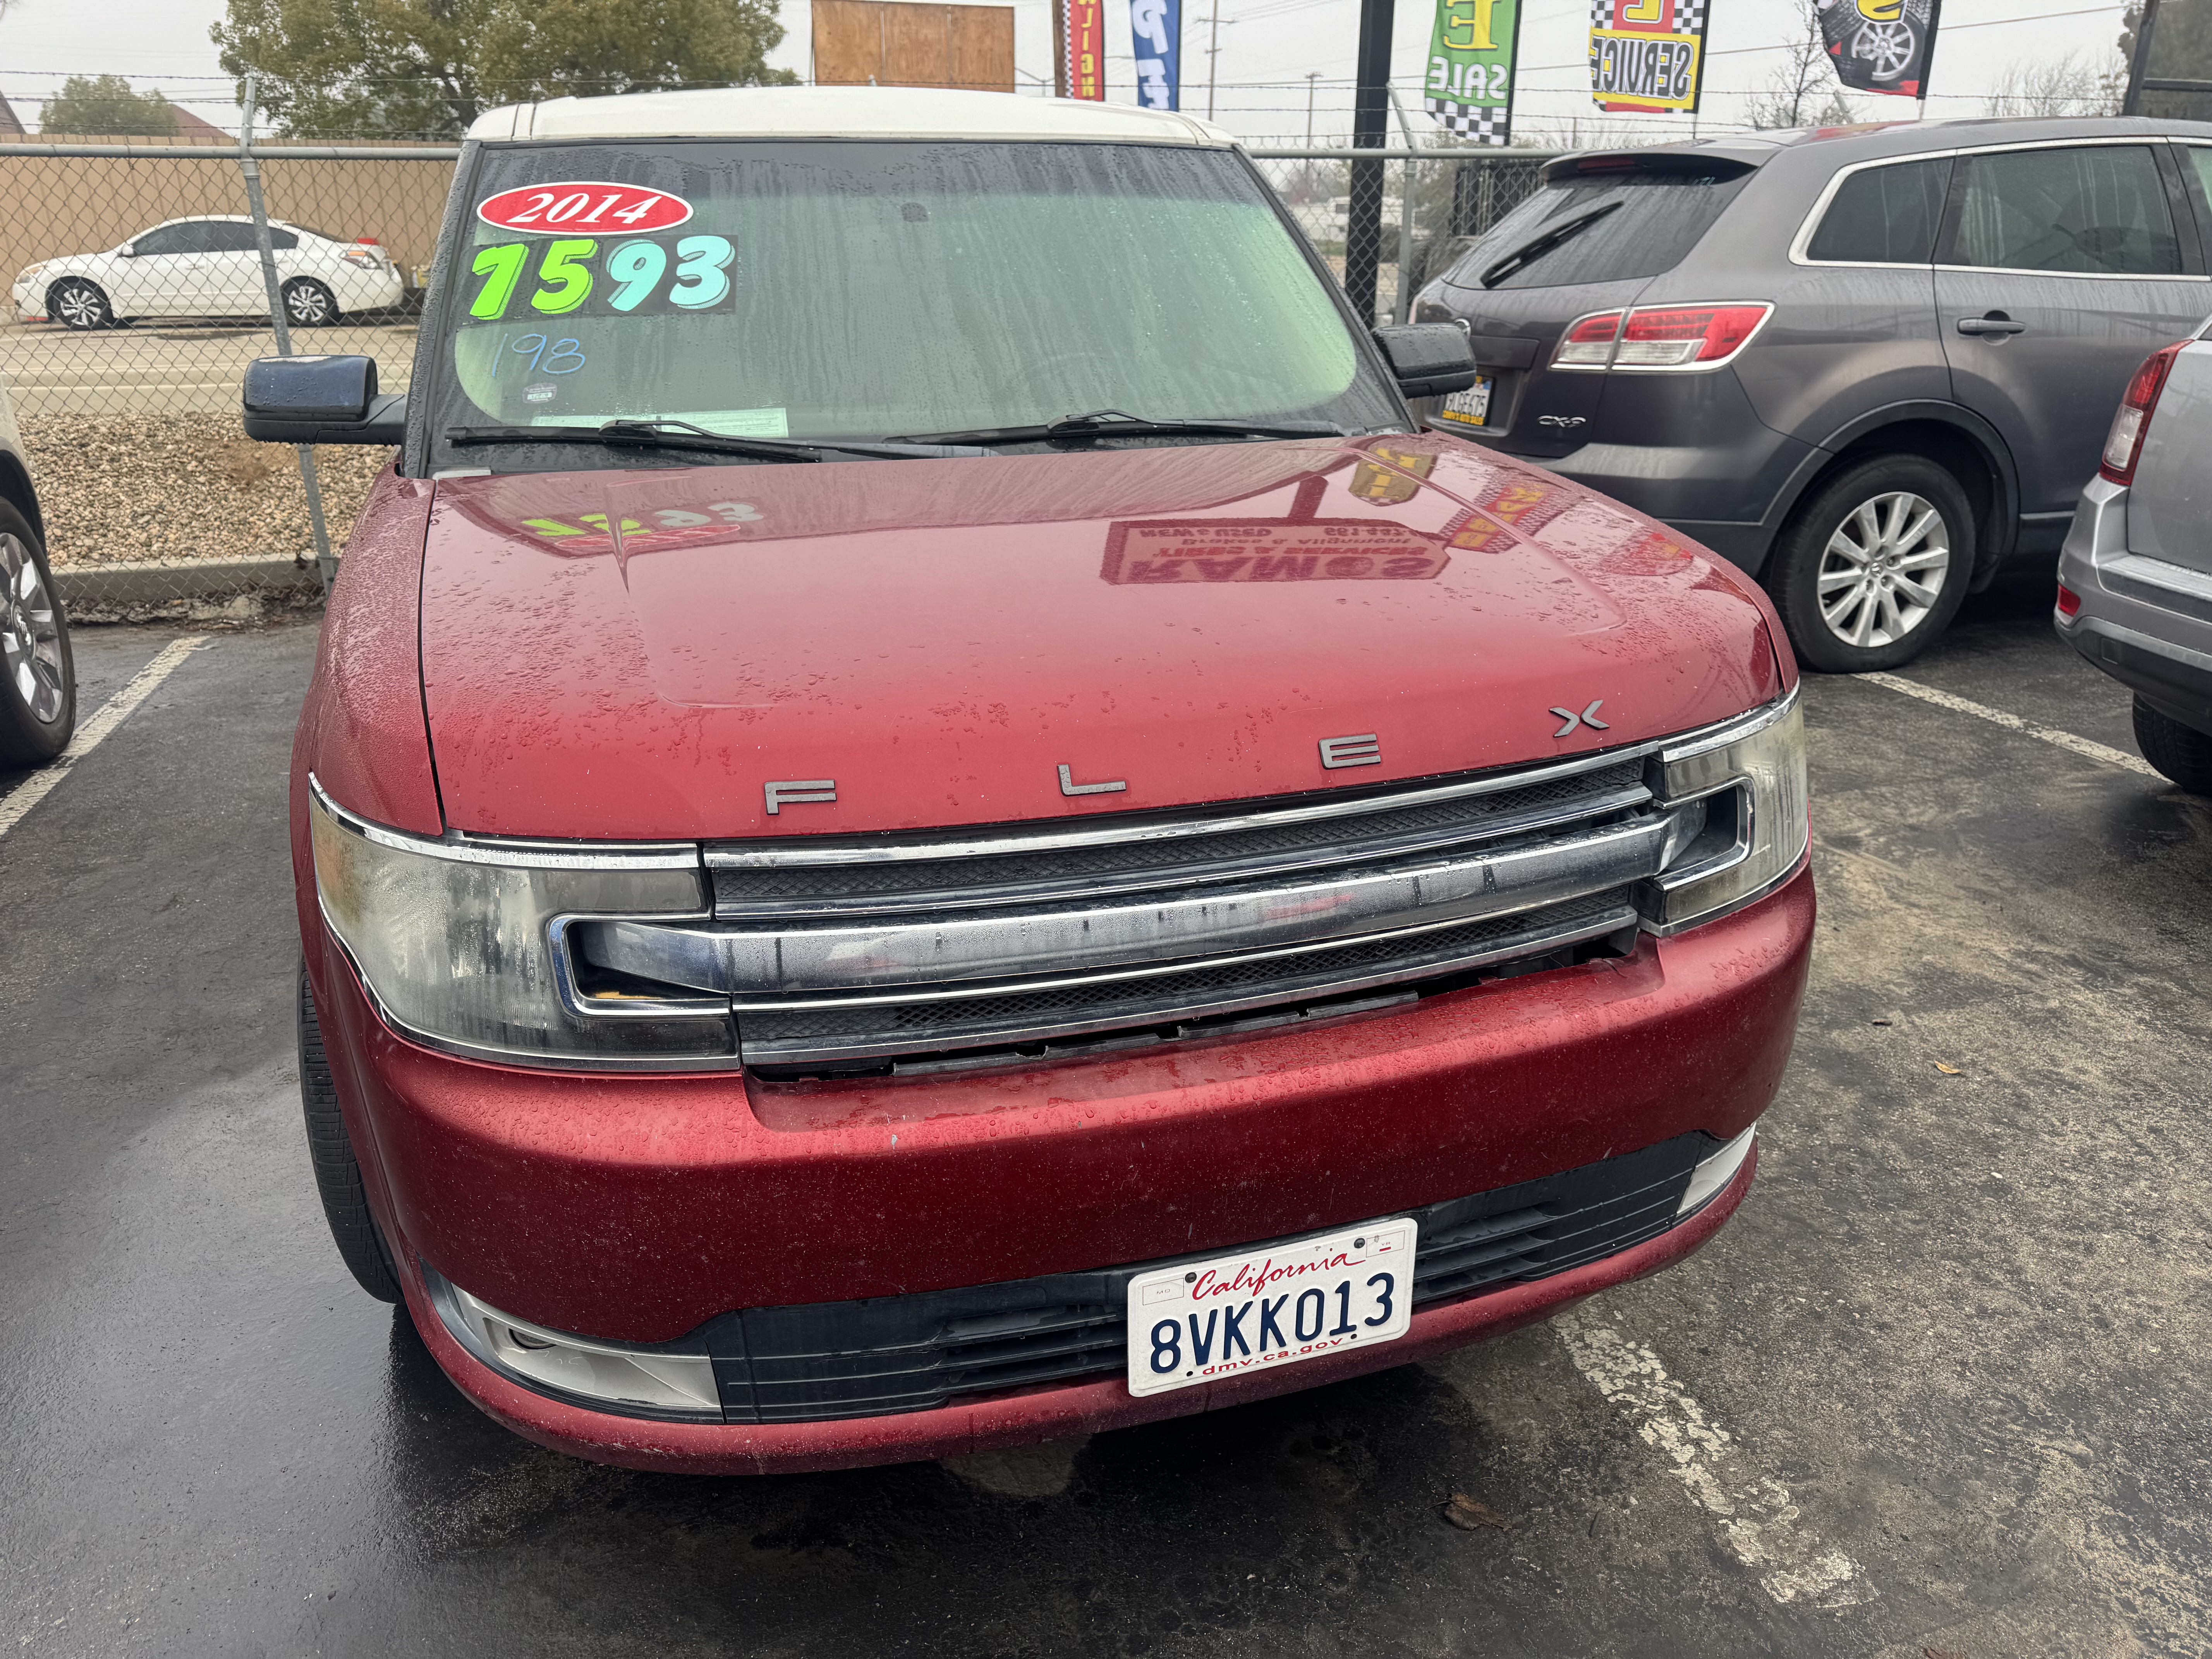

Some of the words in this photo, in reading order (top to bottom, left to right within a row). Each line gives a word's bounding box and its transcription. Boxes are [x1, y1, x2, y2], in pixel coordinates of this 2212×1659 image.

[506, 193, 662, 224] 2014
[491, 333, 586, 377] 198
[1192, 1248, 1366, 1300] California
[1150, 1273, 1394, 1374] 8VKK013
[1202, 1338, 1343, 1375] dmv.ca.gov
